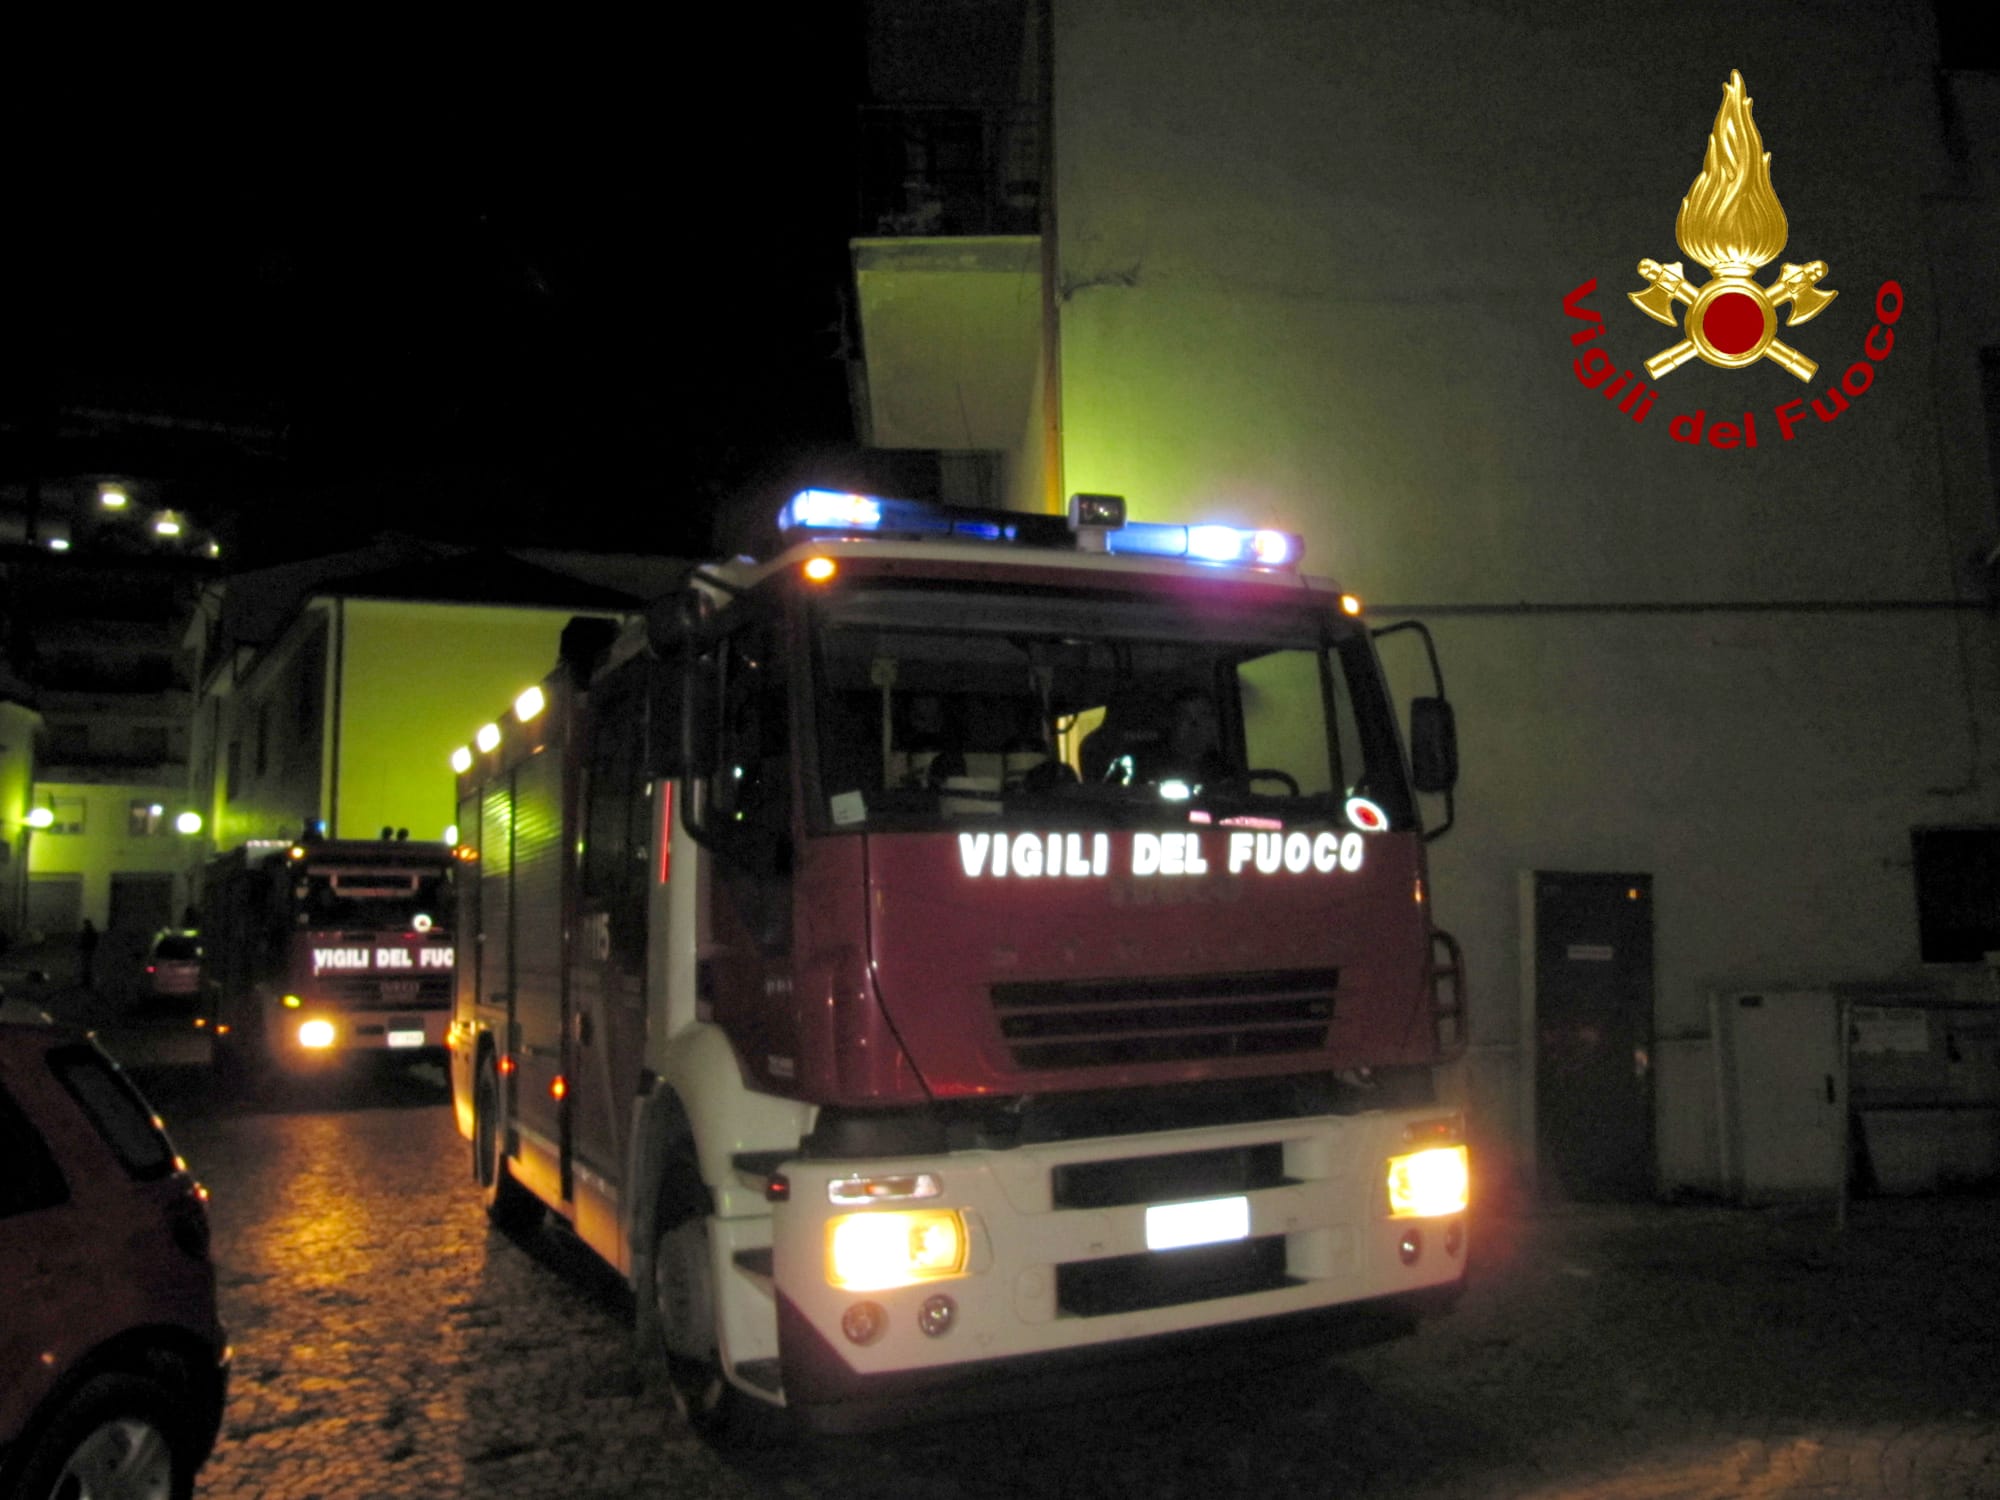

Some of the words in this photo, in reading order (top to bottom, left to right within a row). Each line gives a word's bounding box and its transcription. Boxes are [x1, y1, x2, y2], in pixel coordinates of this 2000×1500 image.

[958, 832, 1110, 878] VIGILI
[1131, 832, 1209, 877] DEL
[1228, 831, 1365, 874] FUOCO
[313, 948, 369, 969] VIGILI
[375, 947, 413, 968] DEL
